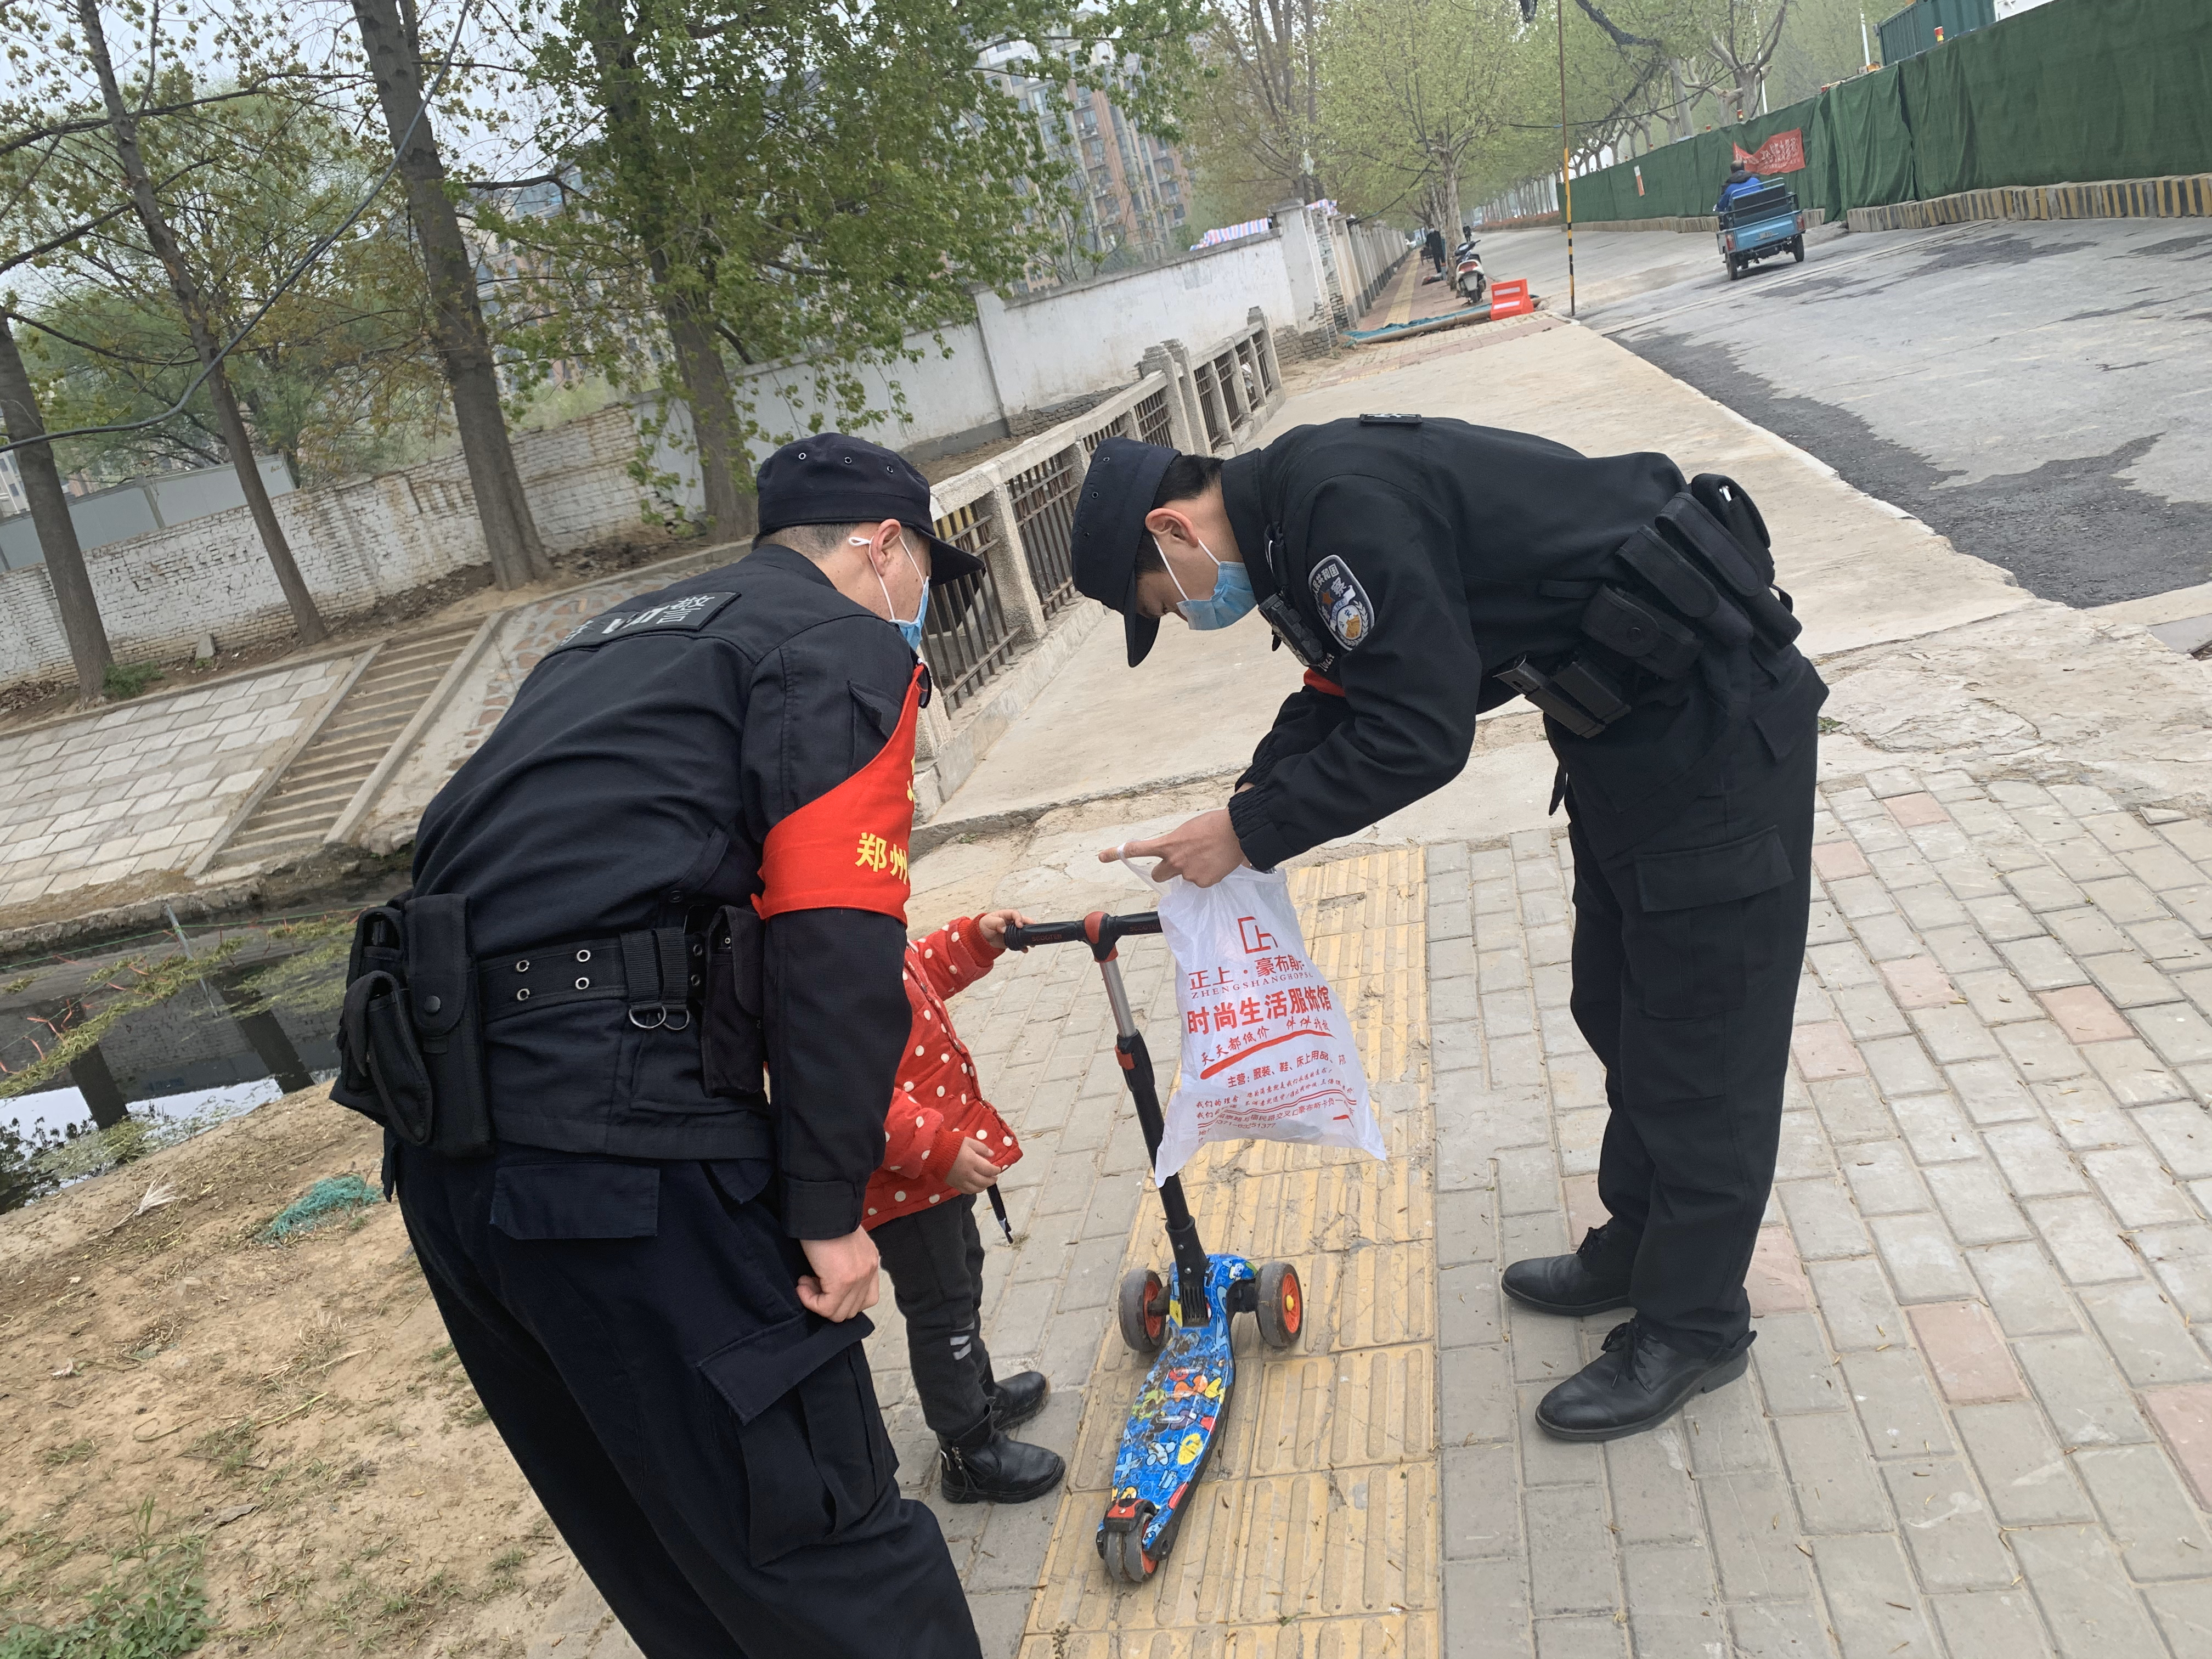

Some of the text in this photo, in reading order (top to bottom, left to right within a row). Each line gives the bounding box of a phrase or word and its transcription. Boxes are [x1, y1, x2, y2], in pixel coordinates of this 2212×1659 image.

[854, 831, 909, 885] 郑州
[1187, 984, 1333, 1036] 时尚生活服饰馆
[1200, 1025, 1270, 1066] 天天都低价
